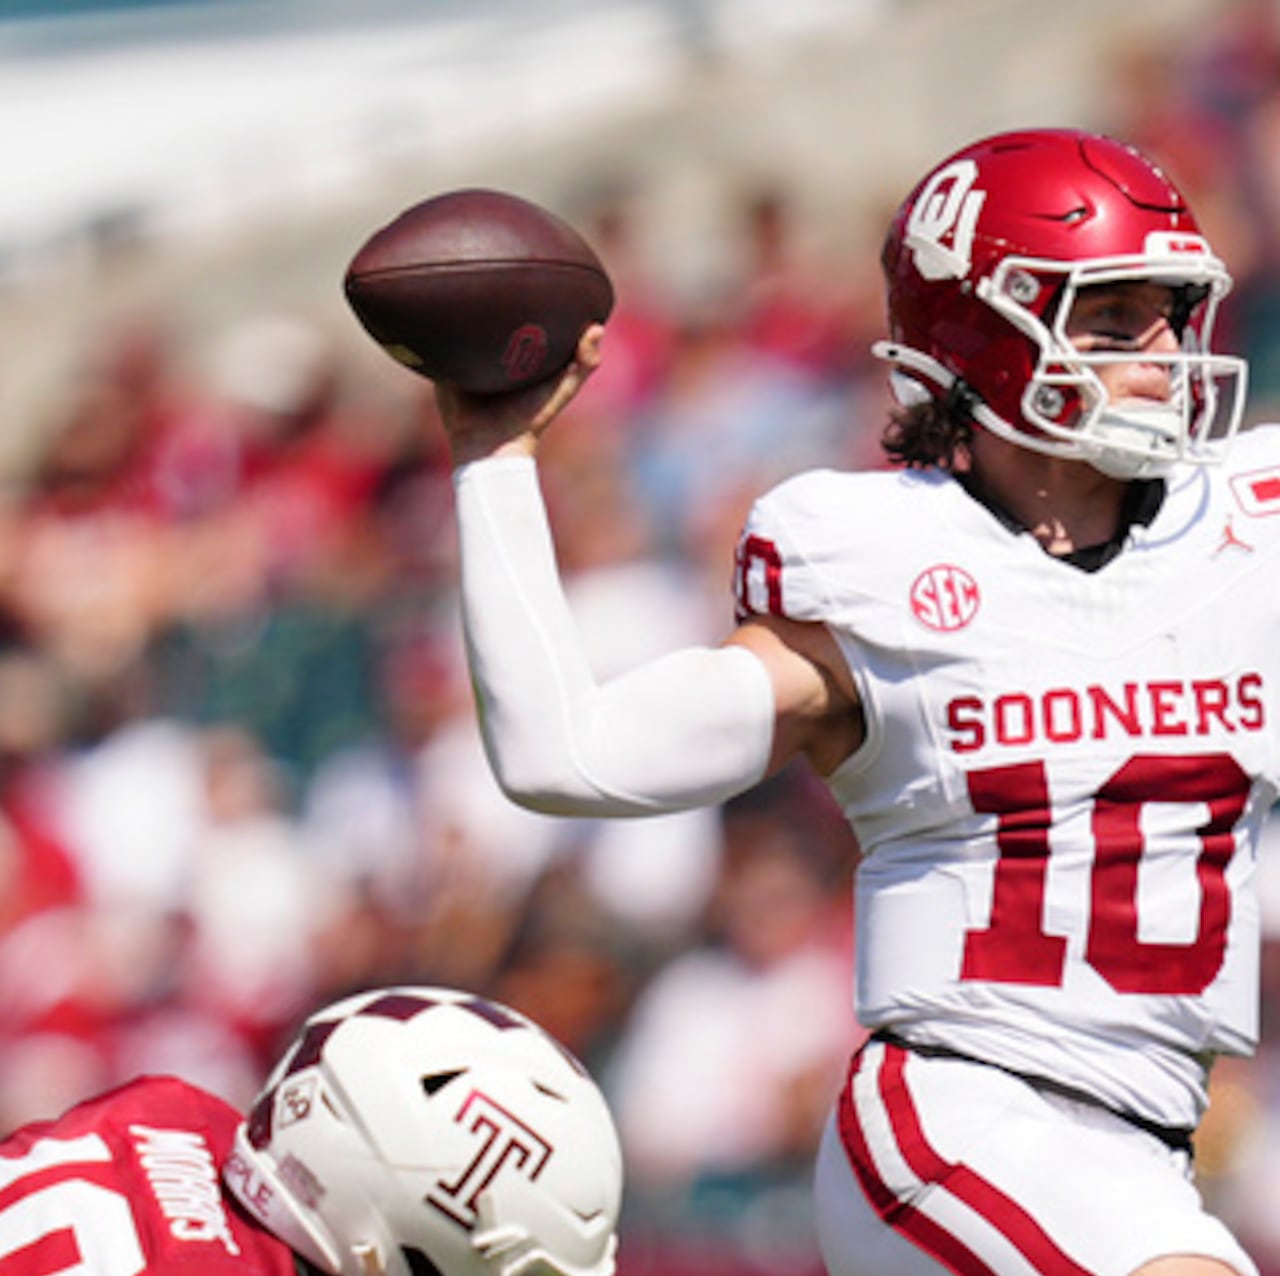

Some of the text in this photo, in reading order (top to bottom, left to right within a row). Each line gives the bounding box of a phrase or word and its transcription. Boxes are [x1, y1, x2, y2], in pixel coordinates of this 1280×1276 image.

[904, 158, 987, 281] OU
[911, 568, 978, 630] SEC
[945, 672, 1266, 754] SOONERS
[959, 752, 1252, 997] 10
[423, 1087, 555, 1232] T
